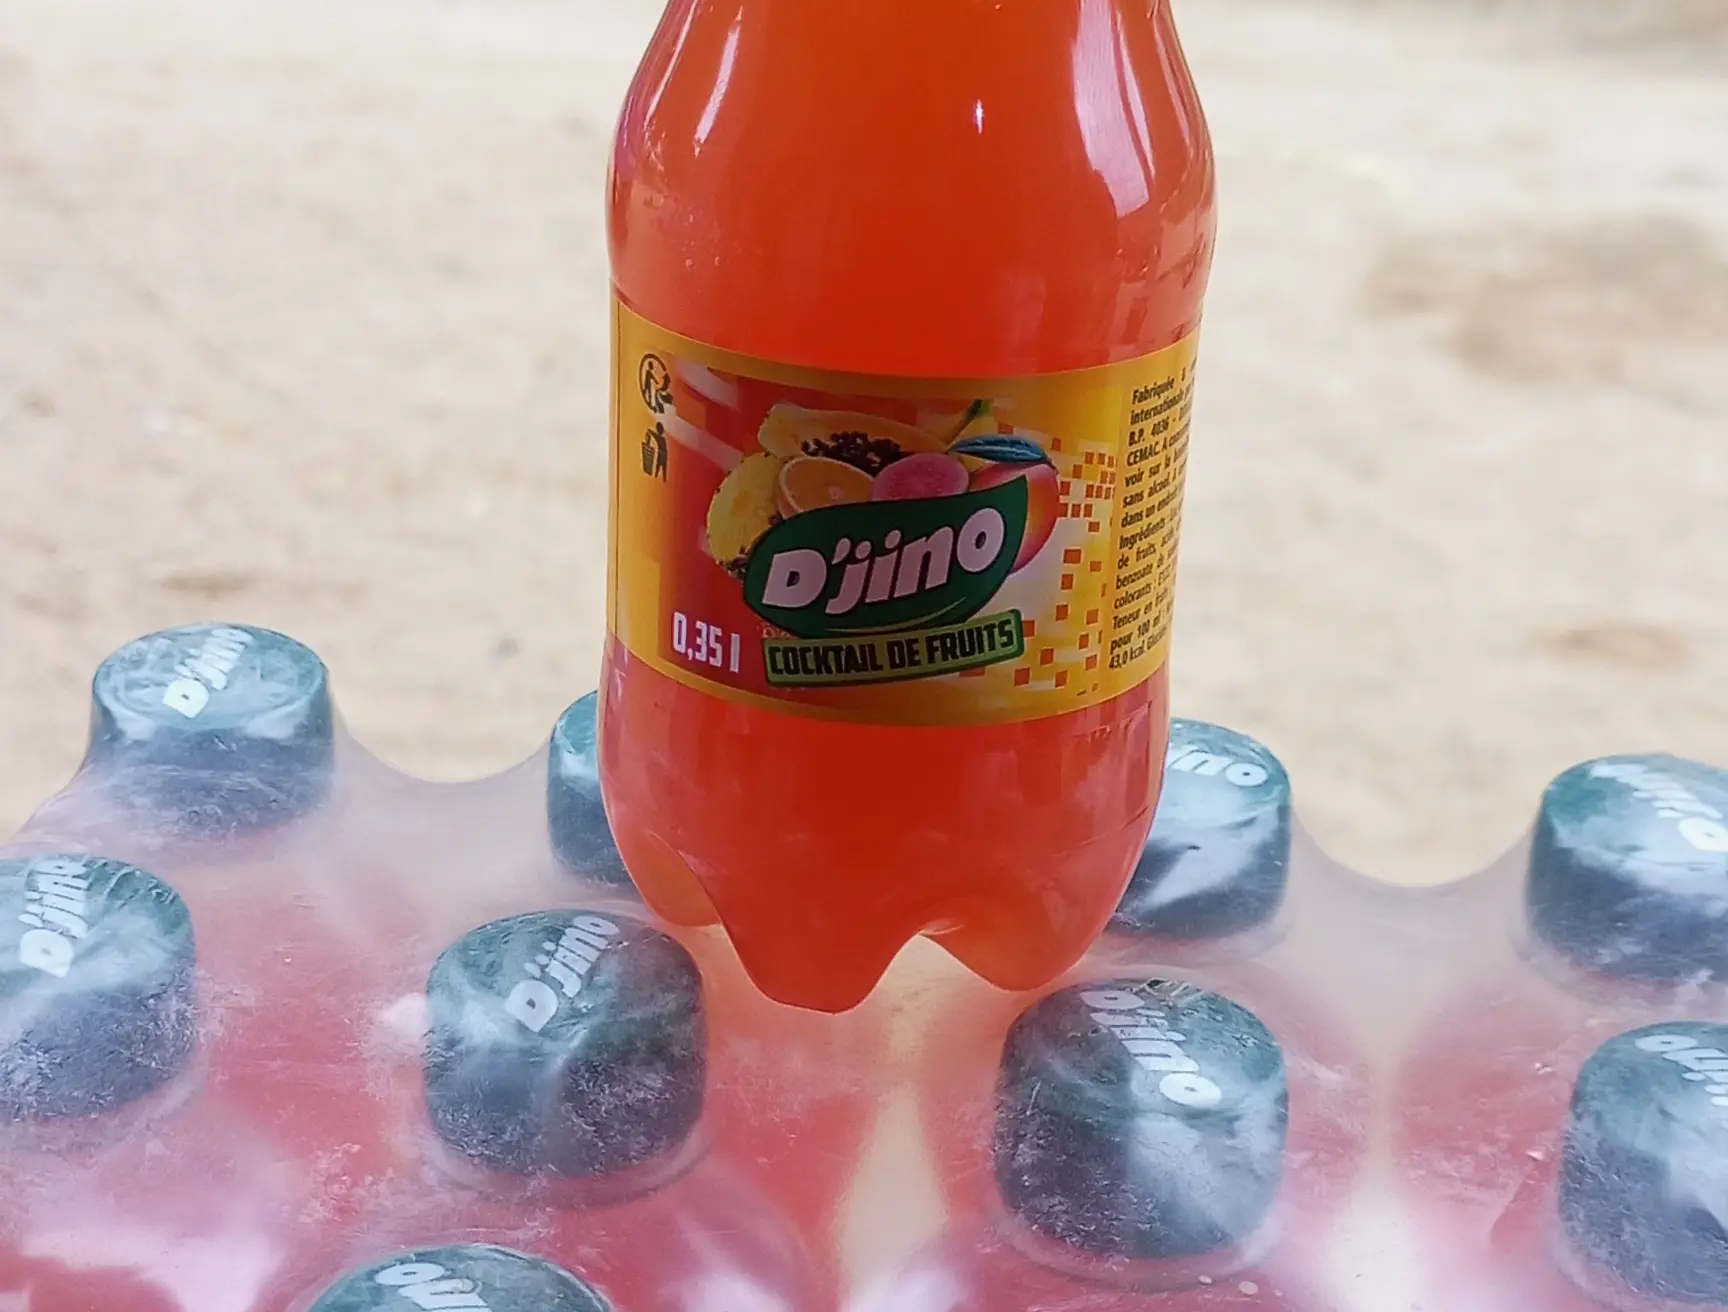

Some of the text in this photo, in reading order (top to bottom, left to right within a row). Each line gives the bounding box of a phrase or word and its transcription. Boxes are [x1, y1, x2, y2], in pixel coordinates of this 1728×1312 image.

[1129, 428, 1145, 447] B.P.
[1125, 468, 1144, 487] voir
[1148, 462, 1161, 478] sur
[1123, 490, 1144, 508] sans
[1121, 510, 1144, 528] dans
[761, 507, 1005, 615] D'jino
[1117, 553, 1129, 569] de
[1116, 563, 1153, 589] benzoate
[1113, 608, 1141, 631] Teneur
[672, 611, 722, 666] 0,35
[767, 618, 1014, 676] COCKTAIL DE FRUITS
[1110, 632, 1133, 655] pour
[504, 915, 621, 1033] D'jino
